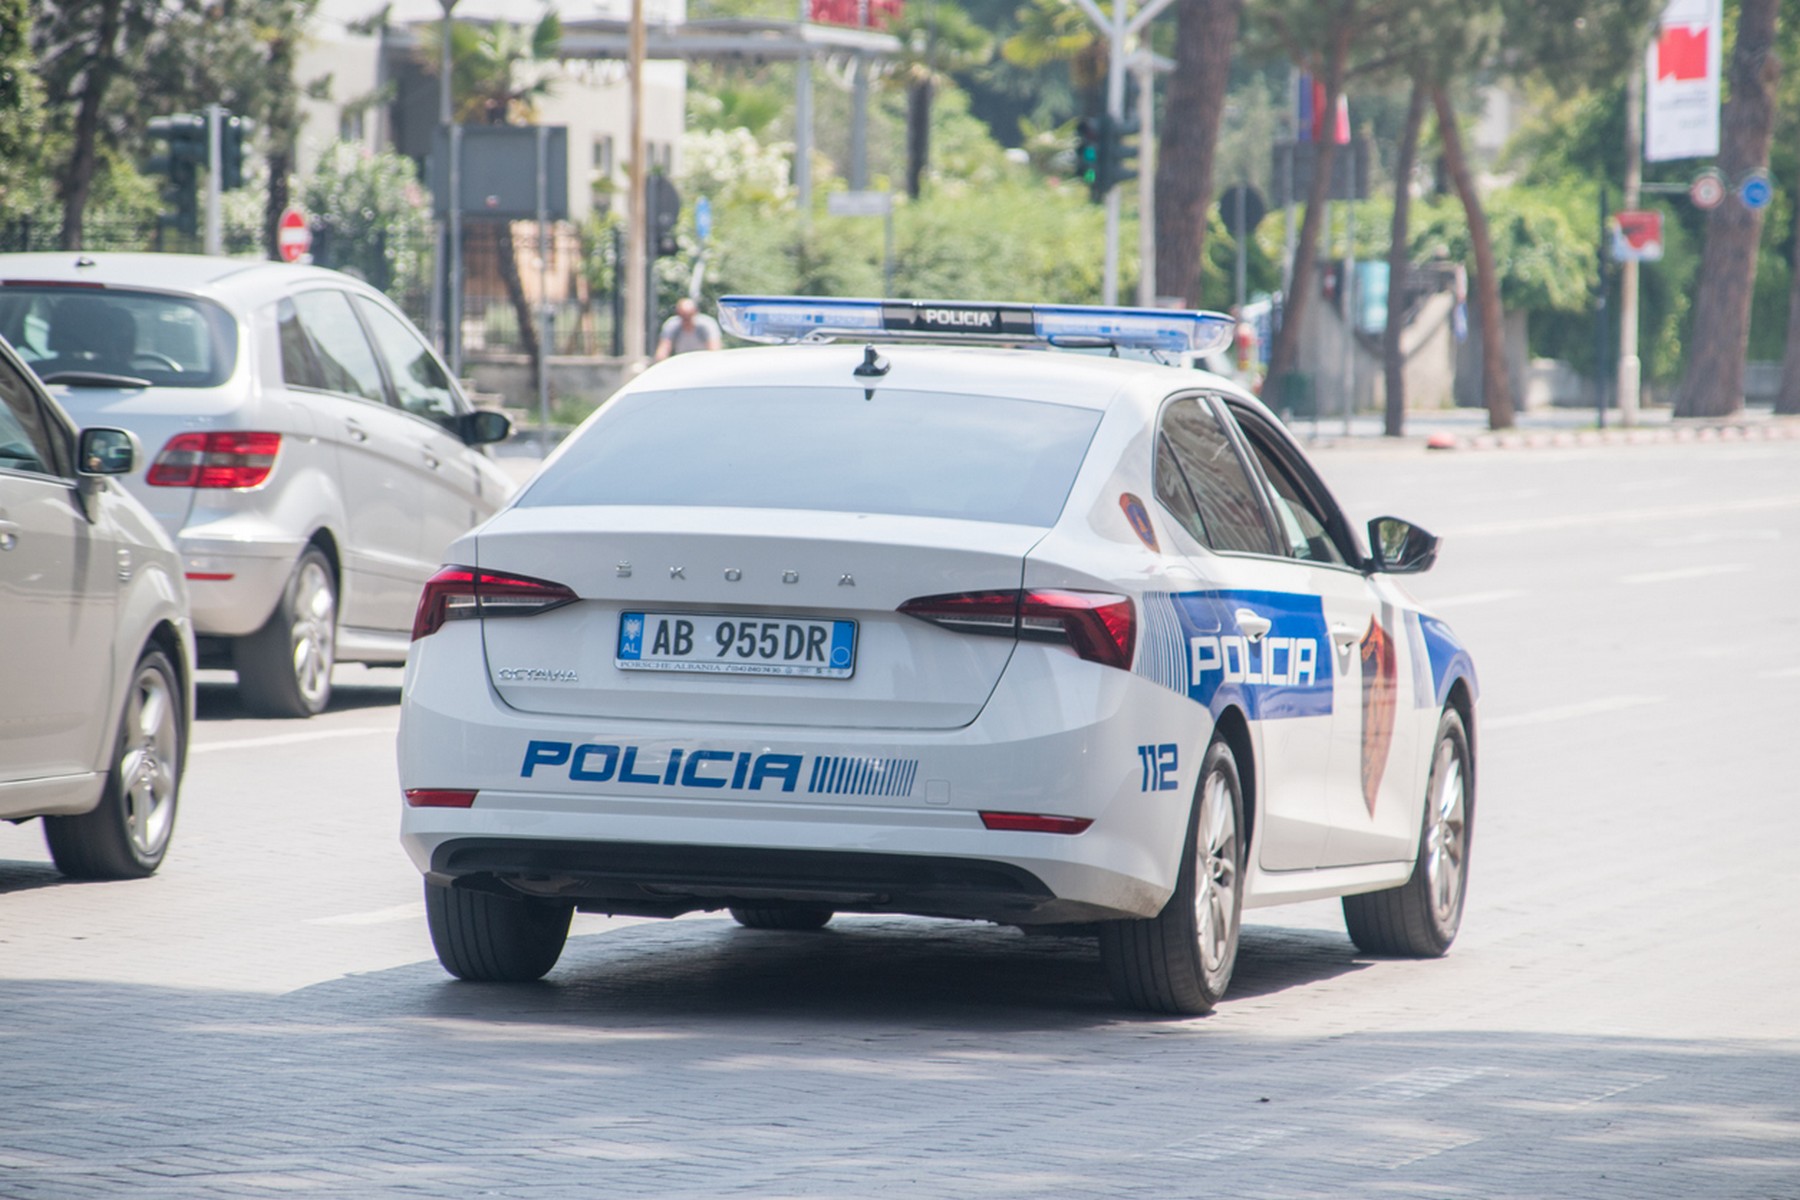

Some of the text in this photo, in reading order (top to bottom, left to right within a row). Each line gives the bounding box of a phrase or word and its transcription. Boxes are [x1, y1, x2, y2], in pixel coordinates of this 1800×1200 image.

[926, 310, 992, 326] POLICIA
[622, 643, 638, 654] AL
[652, 620, 828, 662] AB 955DR
[498, 667, 579, 681] OCTAVIA
[620, 661, 671, 669] PORSCHE
[674, 663, 721, 671] ALBANIA
[1191, 636, 1318, 686] POLICIA
[520, 740, 803, 792] POLICIA
[1138, 743, 1178, 793] 112
